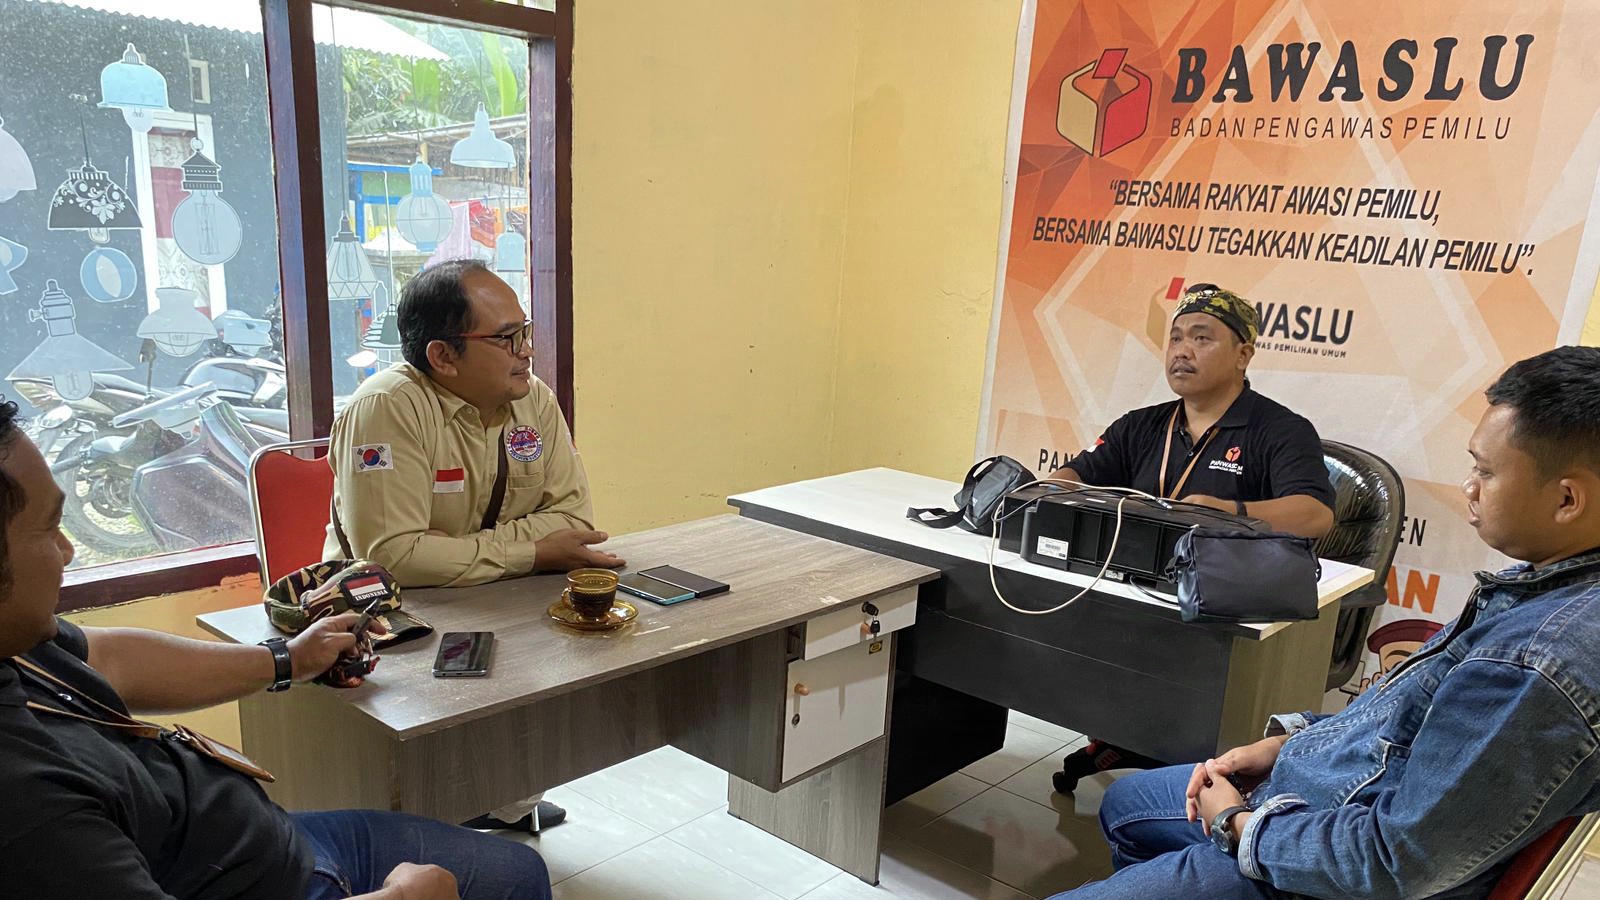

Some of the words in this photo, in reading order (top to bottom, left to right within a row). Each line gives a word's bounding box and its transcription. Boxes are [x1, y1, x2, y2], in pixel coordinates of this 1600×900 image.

[1171, 34, 1535, 103] BAWASLU
[1170, 117, 1245, 138] BADAN
[1253, 117, 1393, 139] PENGAWAS
[1403, 117, 1511, 140] PEMILU
[1109, 179, 1201, 210] “BERSAMA
[1203, 183, 1285, 213] RAKYAT
[1281, 185, 1353, 217] AWASI
[1352, 188, 1441, 226] PEMILU,
[1032, 216, 1112, 247] BERSAMA
[1114, 221, 1204, 253] BAWASLU
[1207, 226, 1315, 261] TEGAKKAN
[1314, 232, 1429, 268] KEADILAN
[1255, 302, 1354, 345] WASLU
[1274, 343, 1319, 356] PEMILIHAN
[1321, 348, 1347, 359] UMUM
[1209, 460, 1244, 471] PANWASCM
[354, 589, 389, 601] INDONESIA
